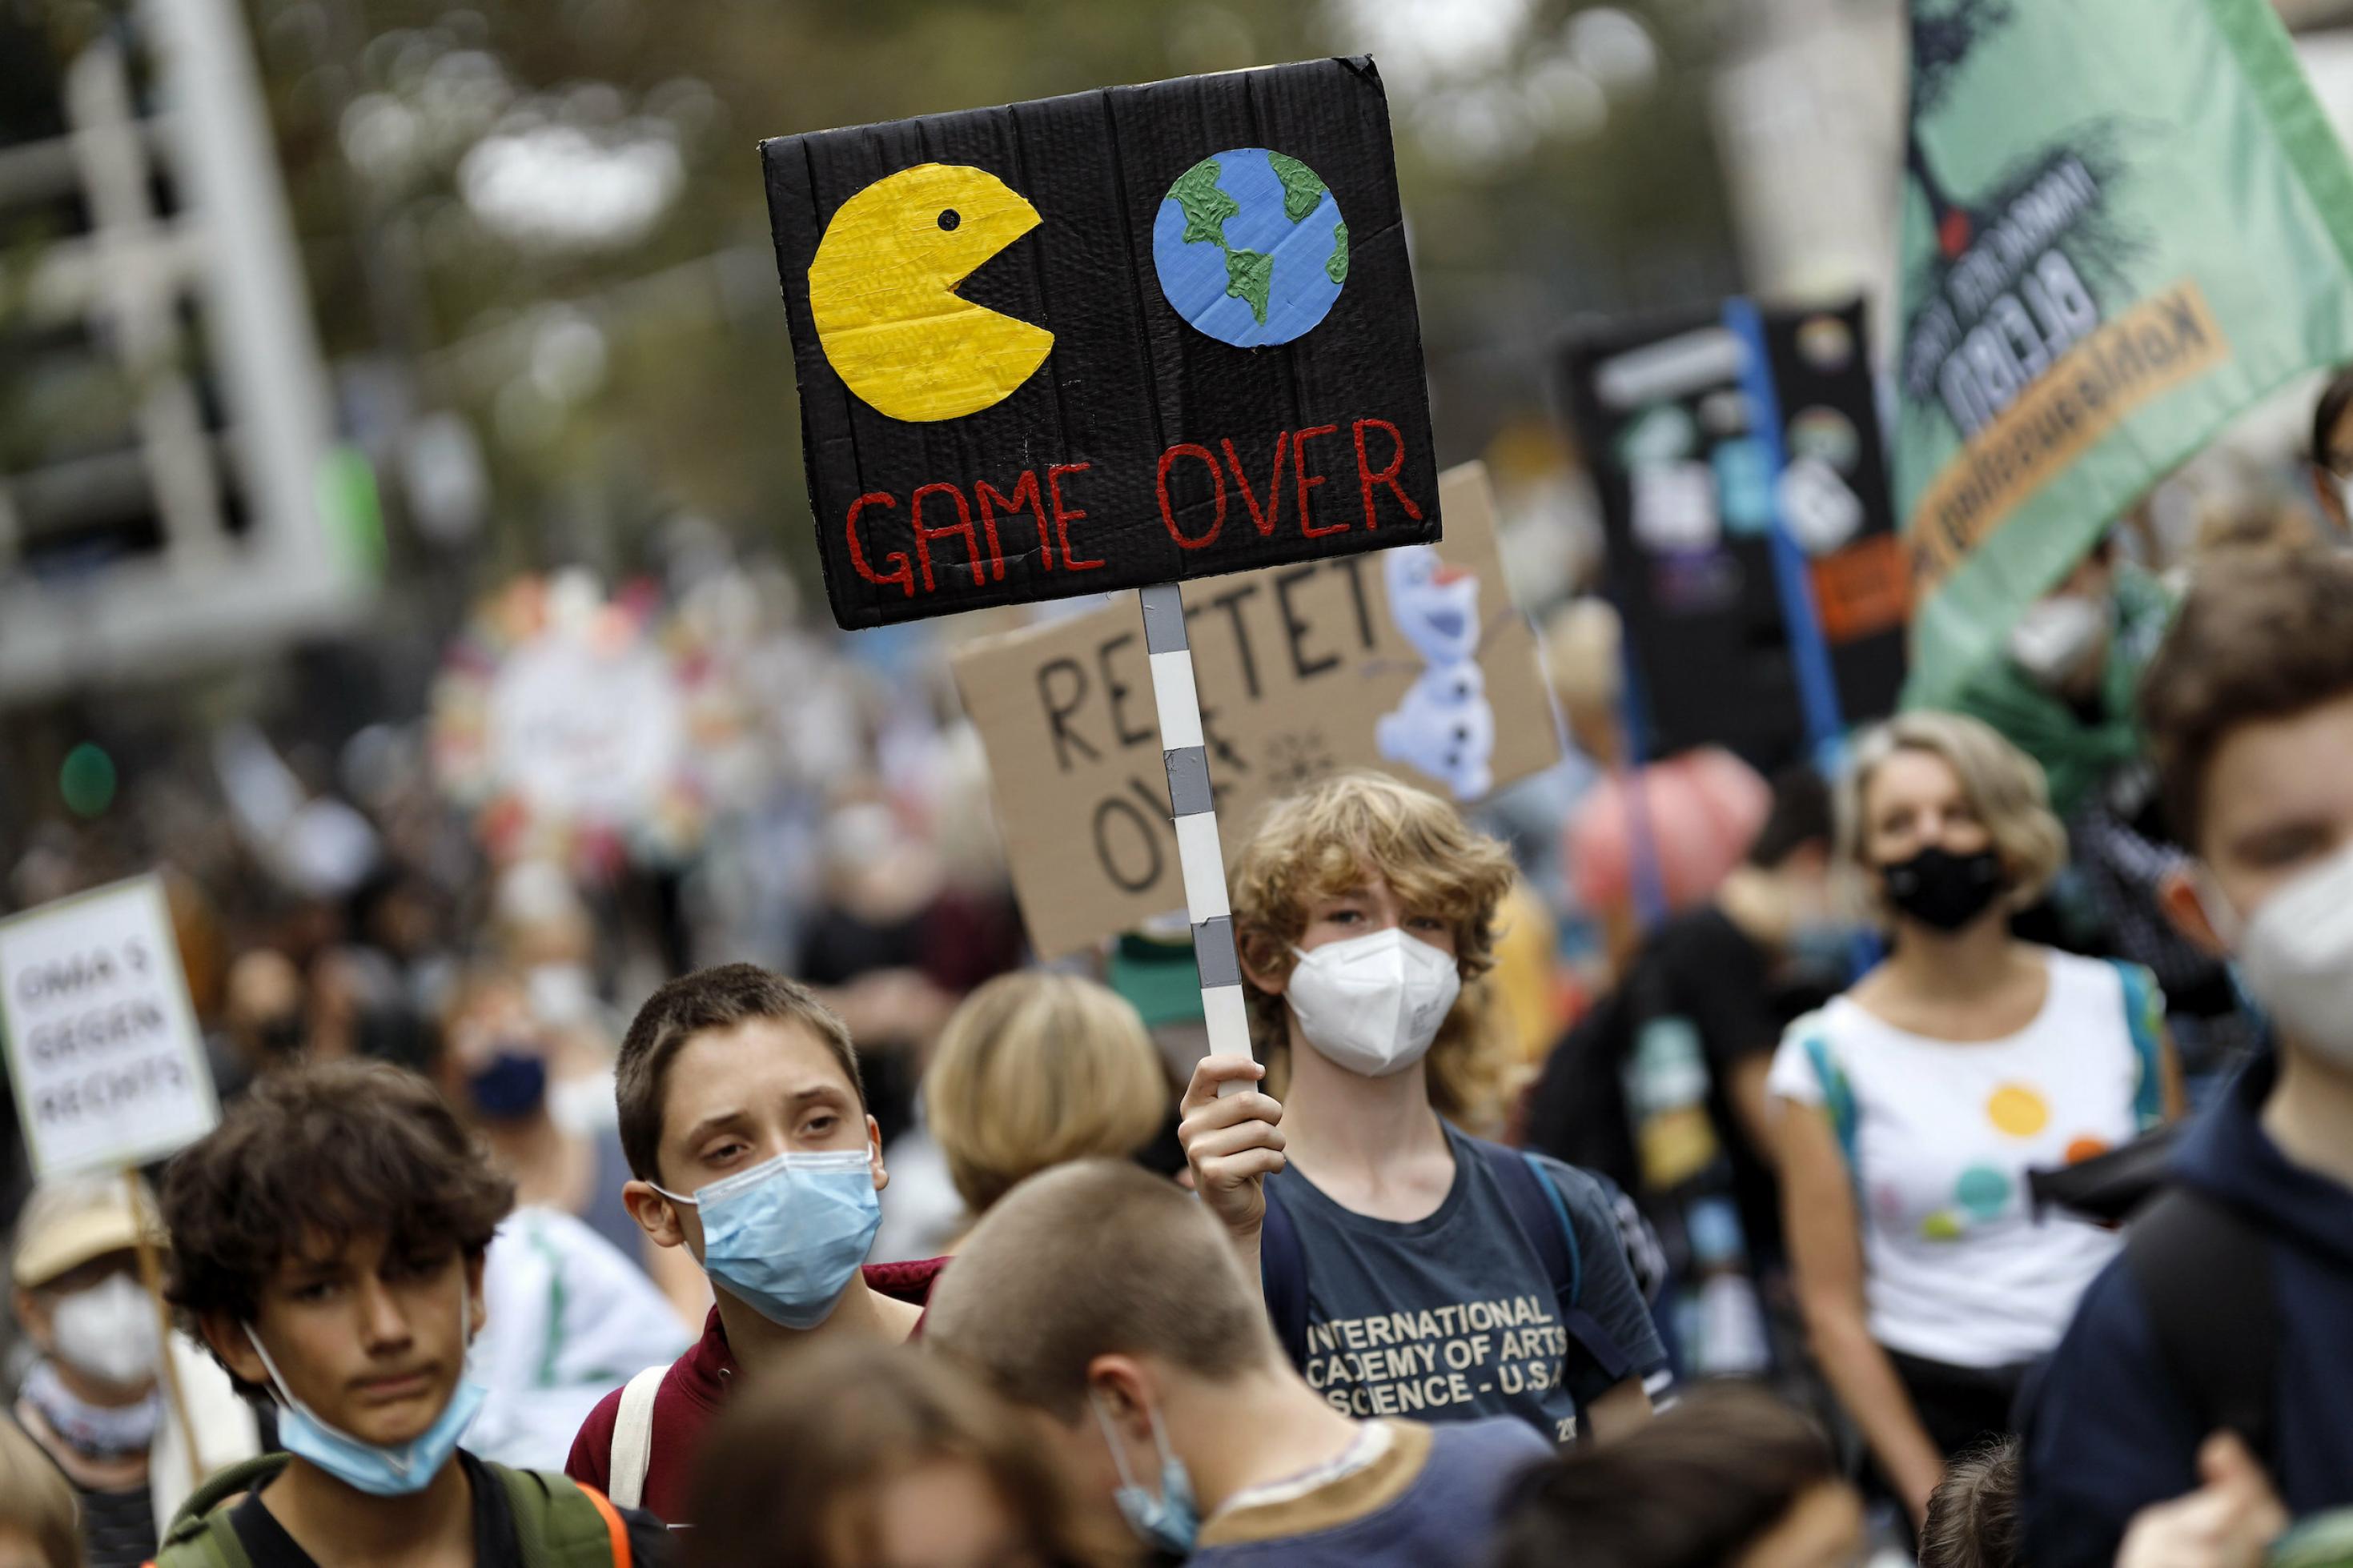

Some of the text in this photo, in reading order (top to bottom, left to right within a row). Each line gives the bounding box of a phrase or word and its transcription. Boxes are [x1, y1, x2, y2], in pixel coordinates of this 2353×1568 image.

[845, 419, 1423, 596] GAME OVER
[1035, 551, 1375, 772] RETET
[1307, 1295, 1553, 1354] INTERNATIONAL
[1307, 1325, 1568, 1389] CADEMY OF ARTS
[1327, 1374, 1473, 1418] SCIENCE
